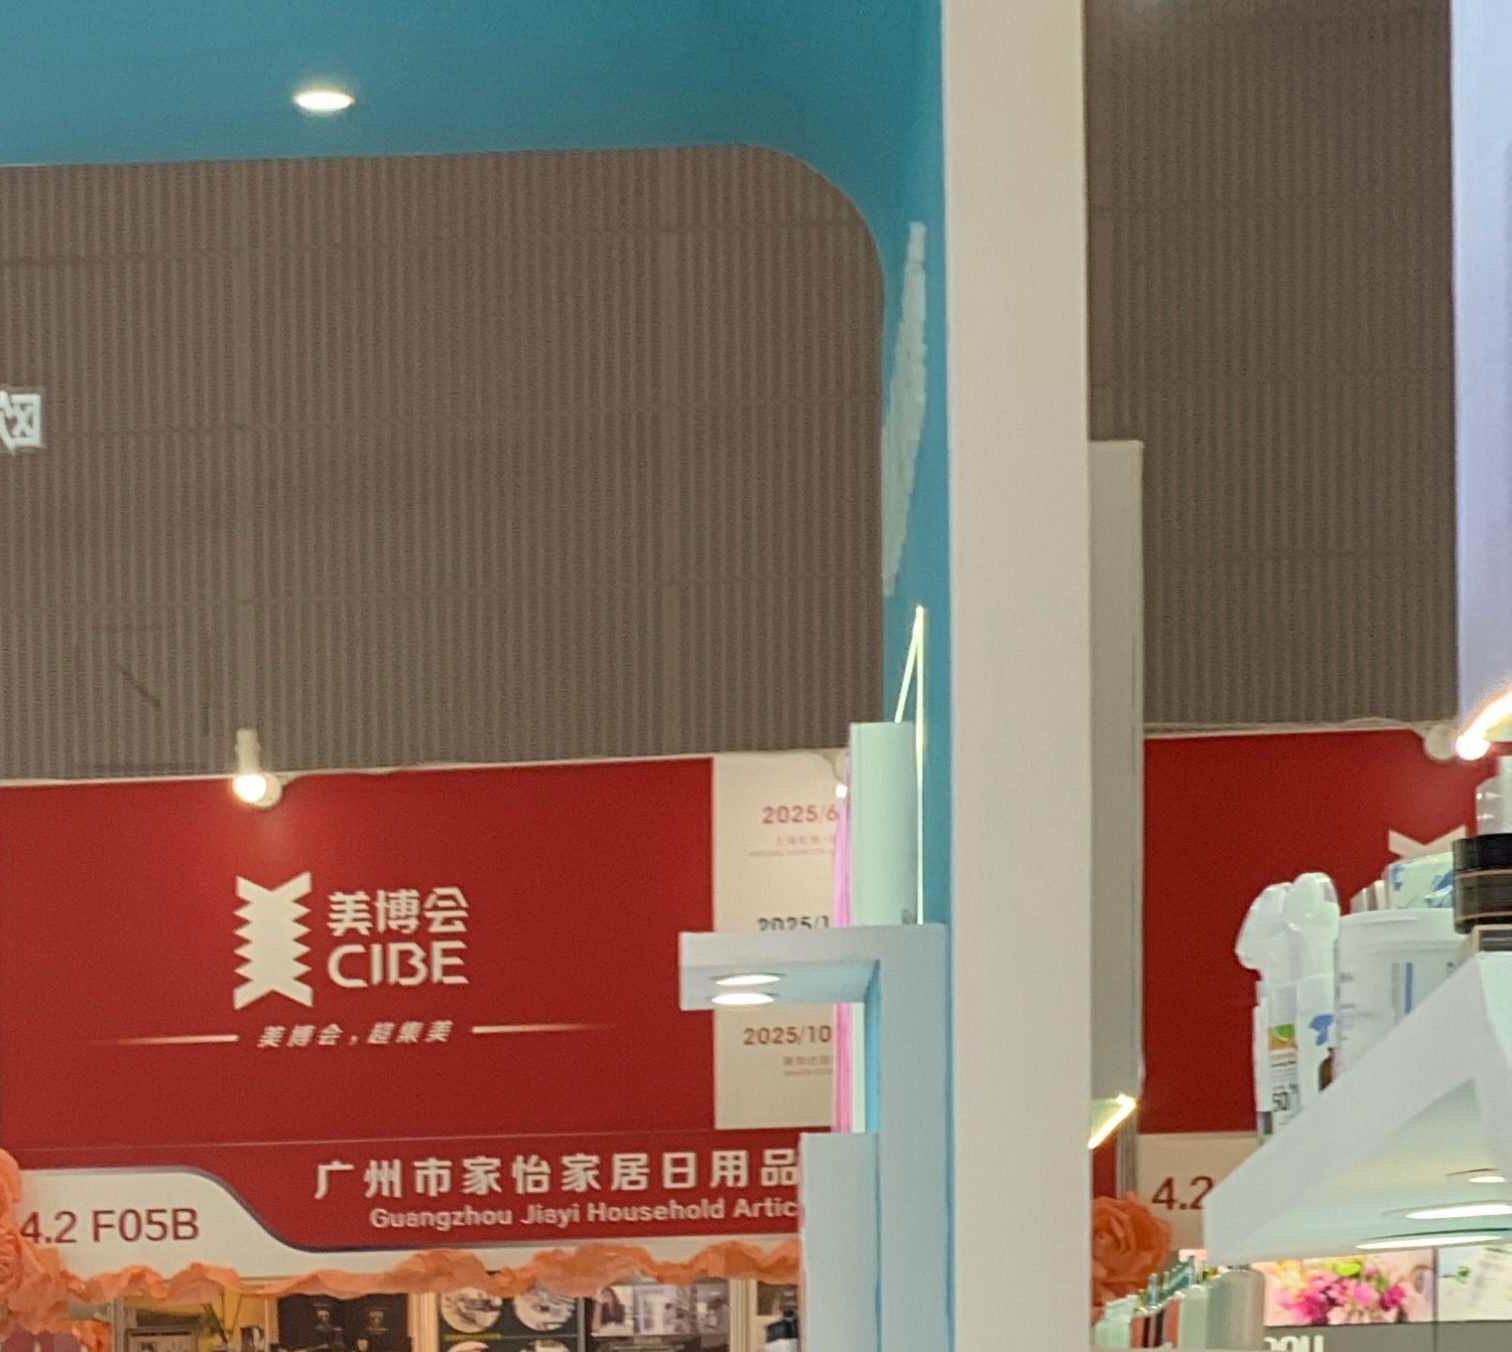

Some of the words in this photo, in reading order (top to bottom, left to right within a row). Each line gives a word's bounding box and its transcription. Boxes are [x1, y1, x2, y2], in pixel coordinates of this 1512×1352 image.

[326, 886, 469, 937] 美博会
[327, 940, 470, 988] CIBE
[314, 1148, 799, 1199] 广州市家怡家居日用品
[20, 1211, 77, 1244] 4.2
[92, 1207, 200, 1242] F05B
[370, 1205, 513, 1232] Guangzhou
[522, 1202, 581, 1229] Jiayi
[587, 1198, 725, 1223] Household
